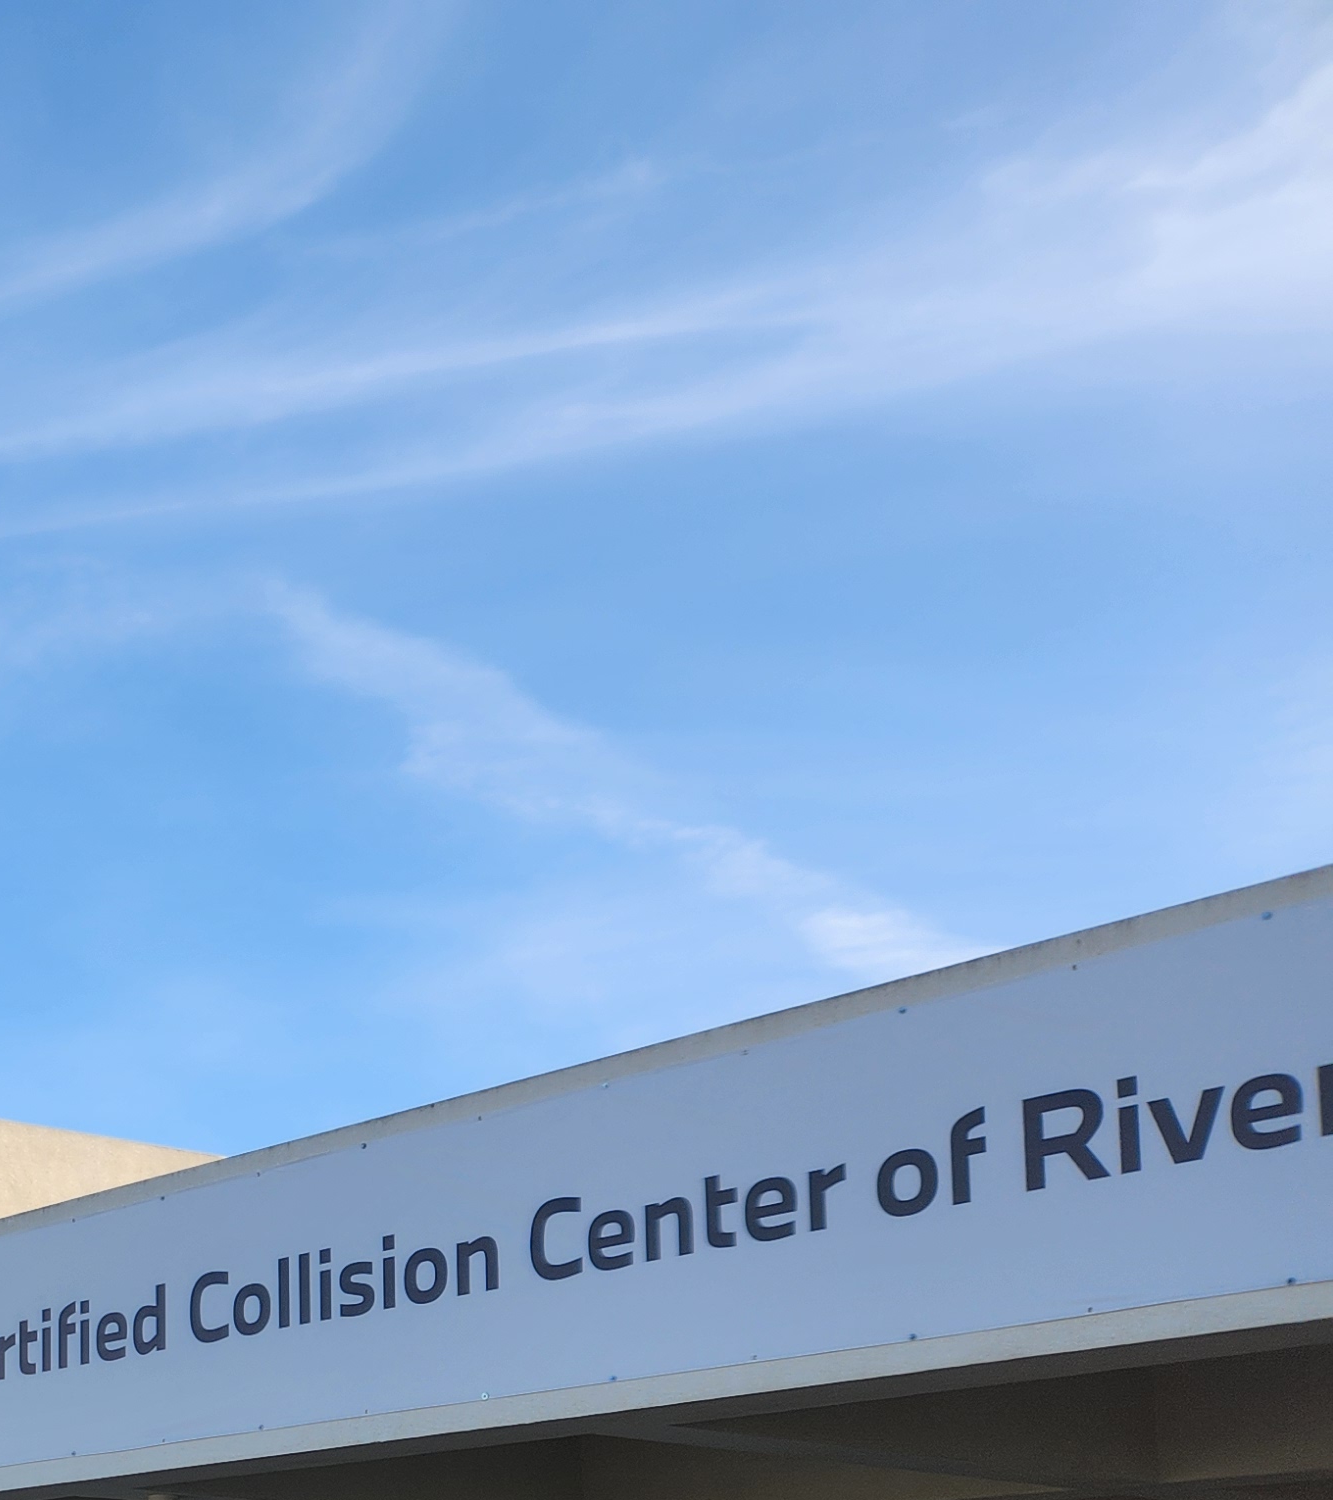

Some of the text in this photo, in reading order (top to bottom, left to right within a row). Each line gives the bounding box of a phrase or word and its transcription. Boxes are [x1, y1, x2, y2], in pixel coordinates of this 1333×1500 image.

[188, 1234, 500, 1344] Collision
[529, 1162, 847, 1281] Center
[876, 1105, 988, 1218] of
